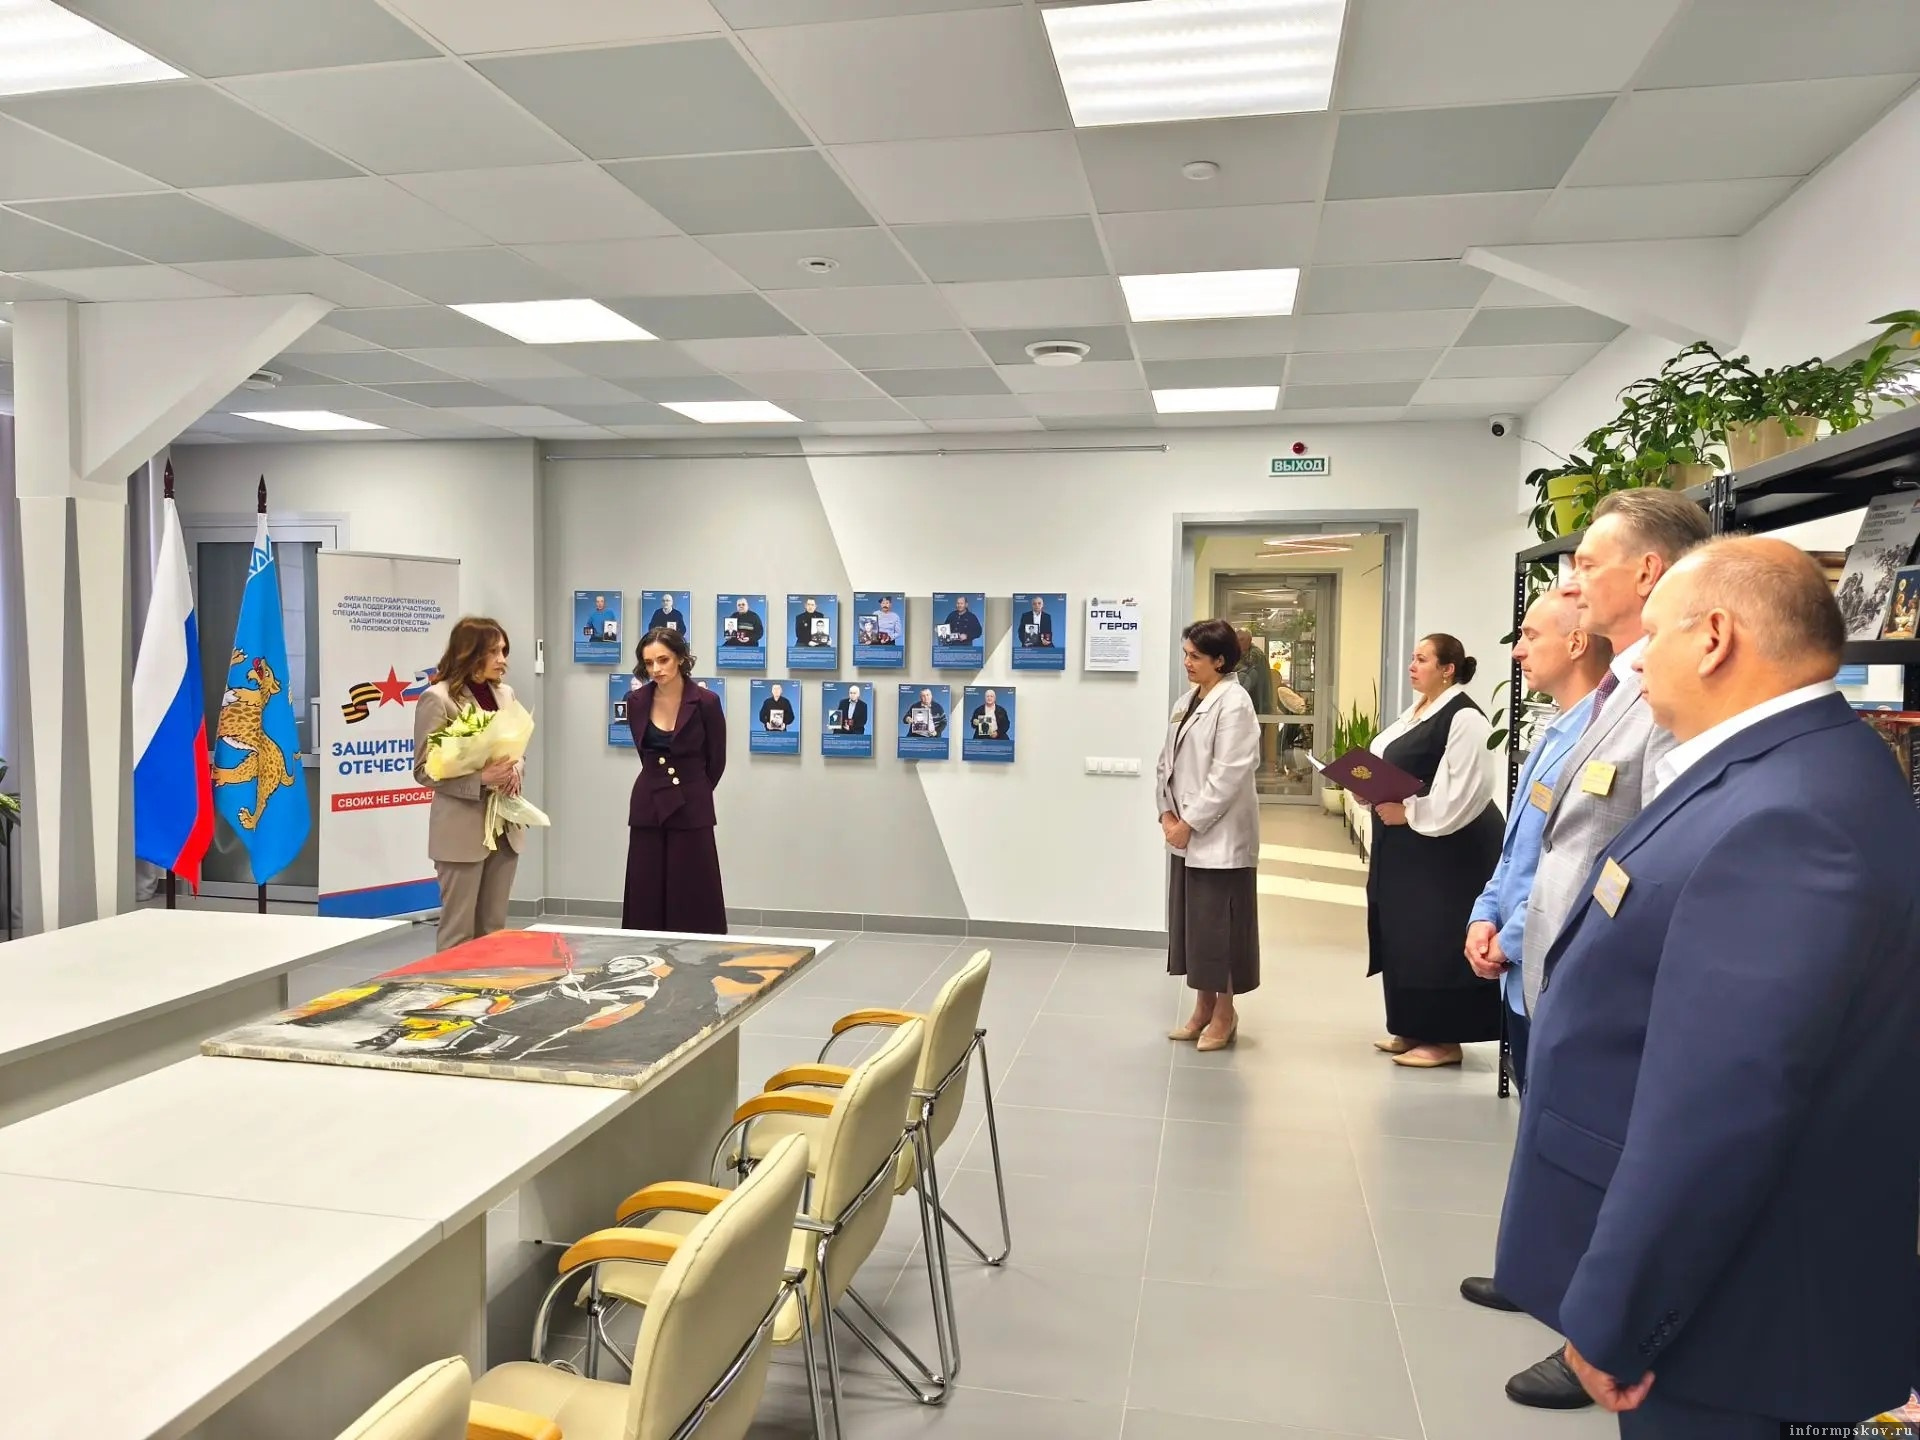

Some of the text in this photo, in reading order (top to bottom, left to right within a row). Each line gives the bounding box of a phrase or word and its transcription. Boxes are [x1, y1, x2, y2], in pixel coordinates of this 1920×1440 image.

[1274, 460, 1322, 471] ВЫХОД
[373, 597, 435, 605] ГОСУДАРСТВЕННОГО
[332, 609, 381, 617] СПЕЦИАЛЬНОЙ
[1091, 610, 1121, 619] ОТЕЦ
[349, 617, 391, 625] «ЗАЩИТНИКИ
[1099, 622, 1137, 630] ГЕРОЯ
[339, 758, 415, 775] ОТЕЧЕСТ
[338, 796, 374, 808] СВОИХ
[376, 795, 391, 805] НЕ
